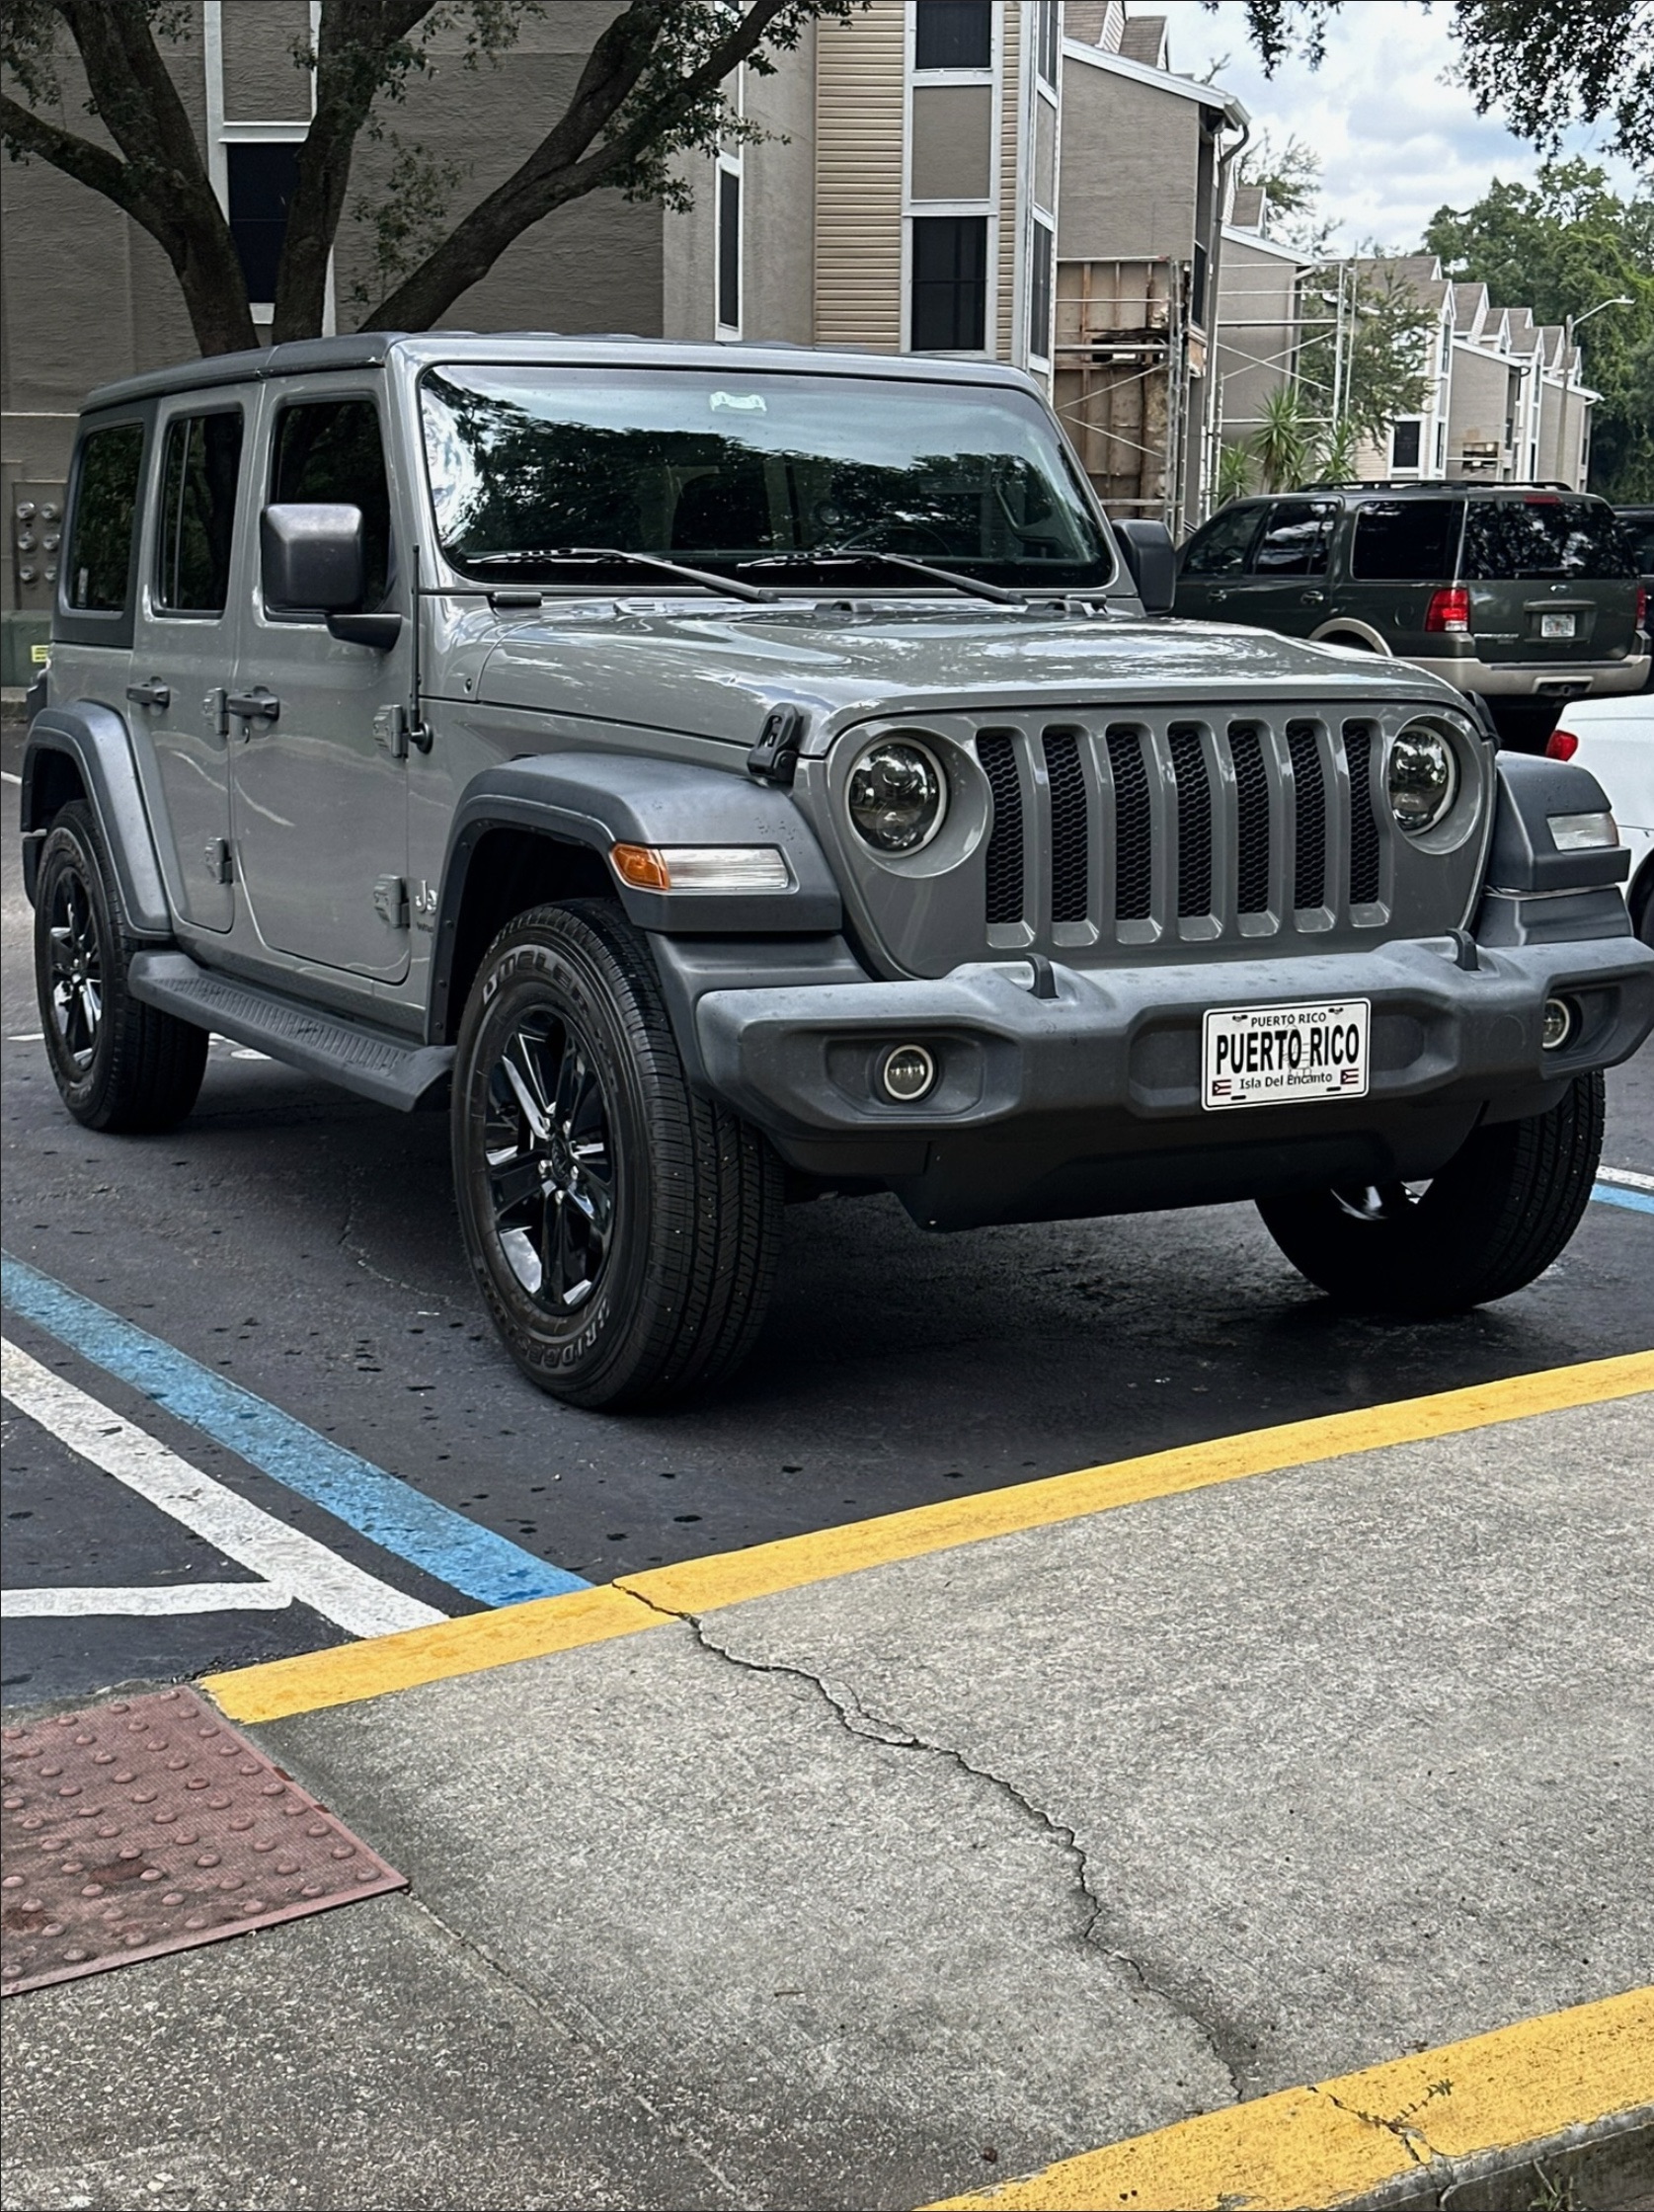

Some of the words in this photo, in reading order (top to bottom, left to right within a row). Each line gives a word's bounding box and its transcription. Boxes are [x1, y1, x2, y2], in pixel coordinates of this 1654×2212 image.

[414, 879, 439, 911] Je
[1251, 1014, 1296, 1028] PUERTO
[1299, 1012, 1327, 1024] RICO
[1217, 1029, 1302, 1075] PUERTO
[1310, 1024, 1360, 1067] RICO
[1239, 1077, 1262, 1090] Isla
[1265, 1074, 1284, 1087] Del
[1287, 1072, 1333, 1086] Encanto
